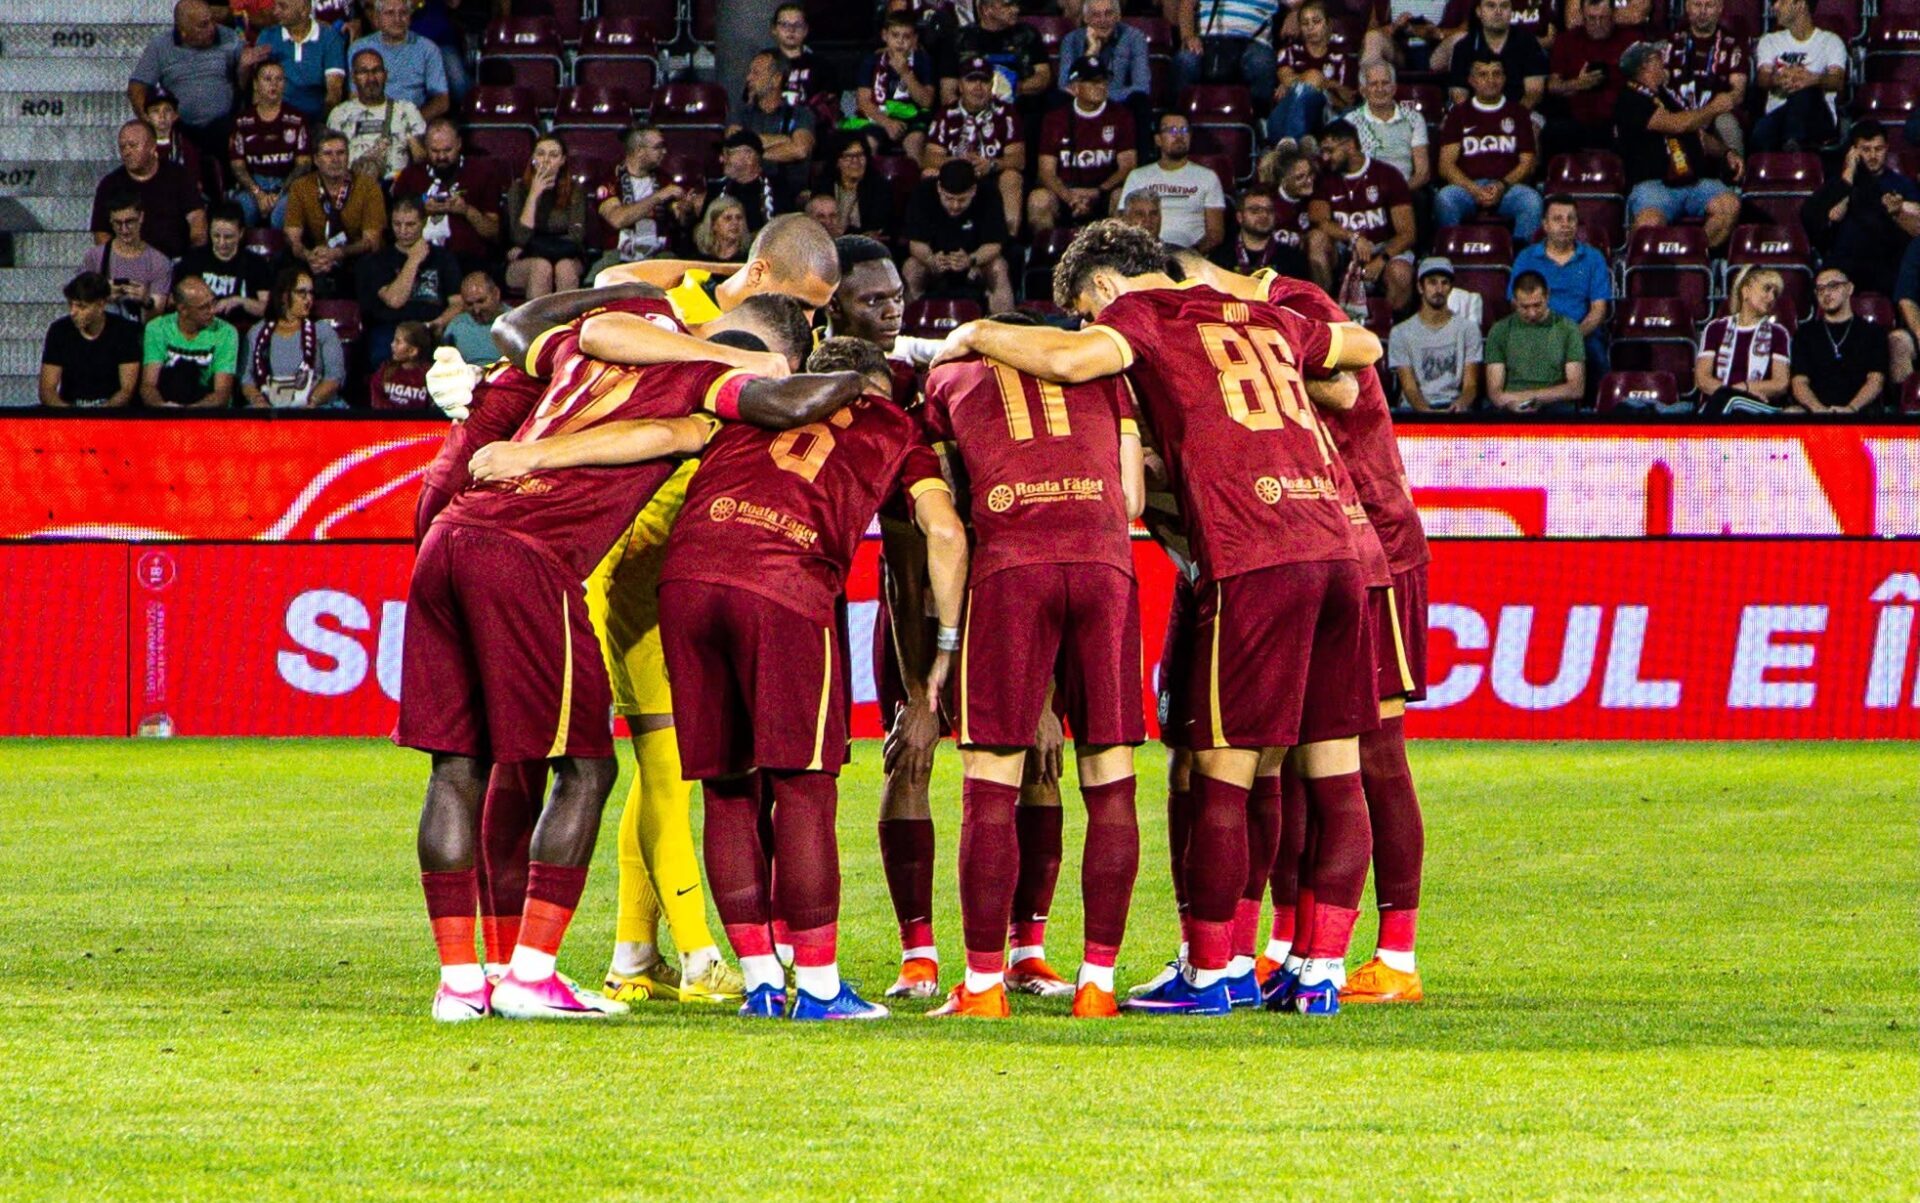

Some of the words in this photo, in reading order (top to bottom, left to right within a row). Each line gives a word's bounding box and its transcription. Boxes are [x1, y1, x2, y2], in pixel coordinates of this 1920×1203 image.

[52, 31, 95, 48] R09
[22, 100, 64, 116] R08
[1223, 302, 1250, 323] KUN
[1197, 322, 1315, 432] 86
[983, 355, 1072, 440] 11
[1015, 480, 1060, 497] Roata
[737, 500, 779, 523] Roata
[277, 589, 408, 703] S
[1727, 604, 1830, 708] E
